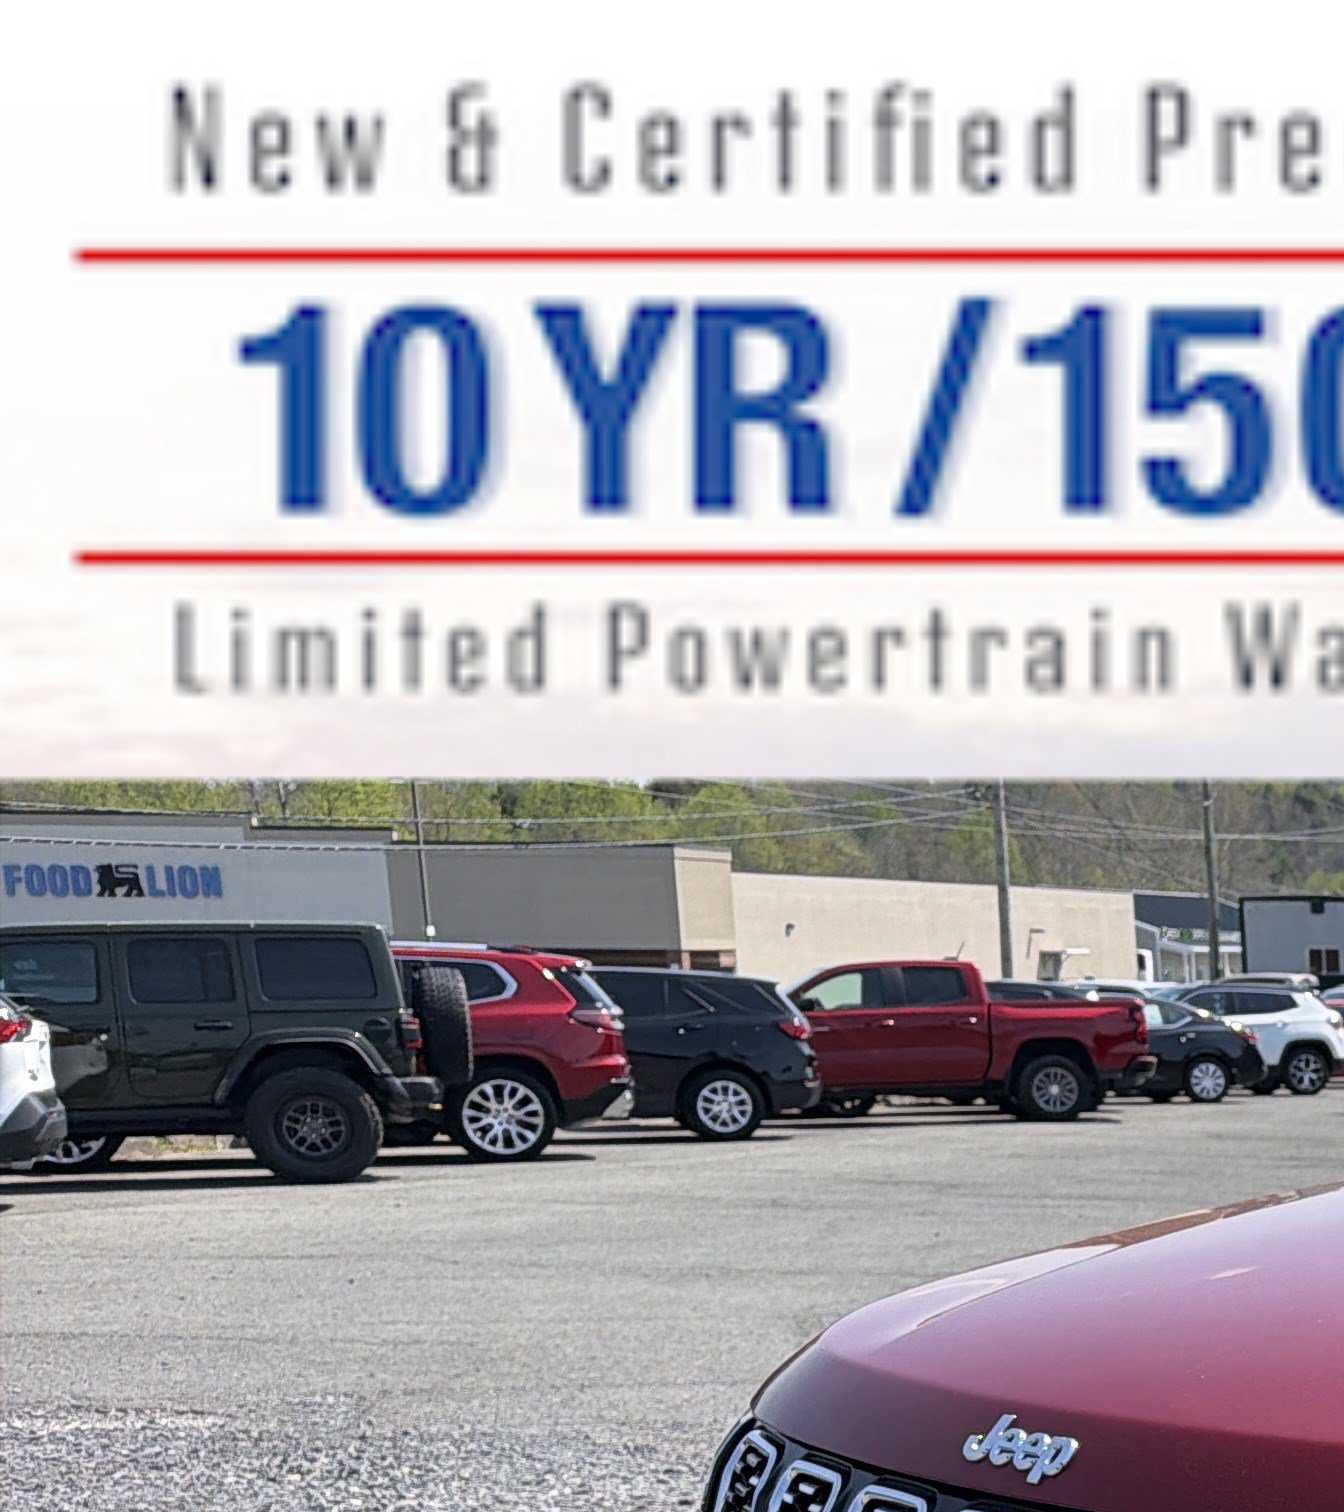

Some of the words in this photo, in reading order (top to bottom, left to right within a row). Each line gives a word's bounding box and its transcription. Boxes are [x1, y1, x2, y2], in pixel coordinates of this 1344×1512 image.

[2, 863, 94, 898] FOOD
[145, 863, 224, 899] LION
[962, 1413, 1079, 1485] Jeep
